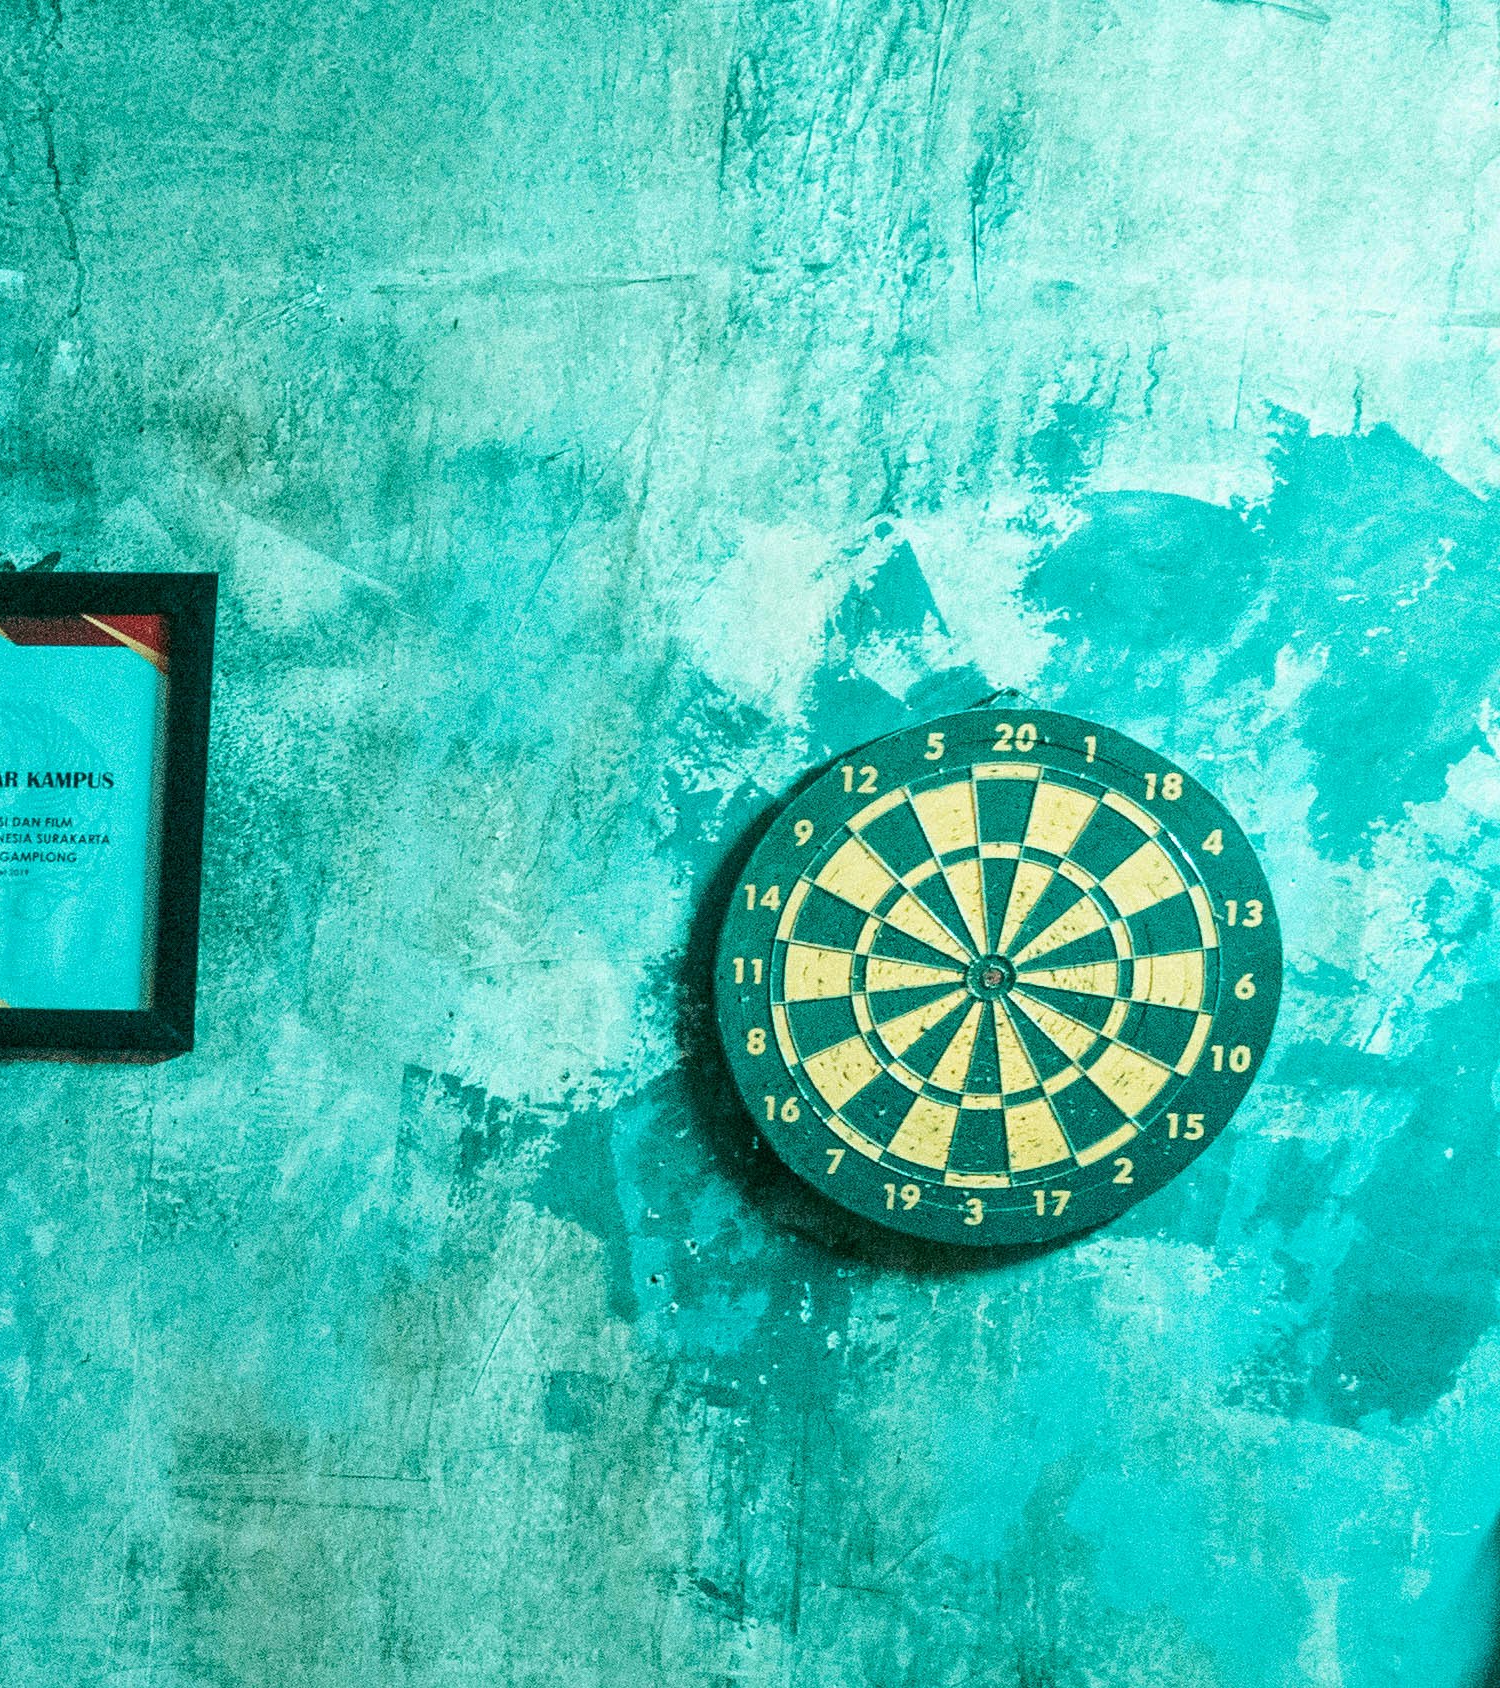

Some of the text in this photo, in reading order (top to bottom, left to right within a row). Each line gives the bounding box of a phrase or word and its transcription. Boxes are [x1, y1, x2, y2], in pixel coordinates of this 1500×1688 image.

[923, 731, 946, 760] 5
[992, 723, 1039, 752] 20
[1082, 735, 1098, 763] 1
[27, 771, 115, 789] KAMPUS
[841, 765, 880, 794] 12
[1143, 772, 1185, 801] 18
[12, 816, 41, 828] DAN
[44, 817, 74, 828] FILM
[793, 819, 815, 846] 9
[36, 833, 111, 845] SURAKARTA
[1201, 828, 1224, 856] 4
[744, 884, 781, 912] 14
[1224, 899, 1264, 927] 13
[733, 957, 764, 985] 11
[1234, 973, 1257, 1000] 6
[746, 1028, 767, 1055] 8
[1211, 1044, 1252, 1074] 10
[763, 1095, 800, 1123] 16
[1166, 1112, 1206, 1141] 15
[825, 1148, 845, 1174] 7
[1113, 1156, 1135, 1185] 2
[883, 1183, 922, 1211] 19
[1032, 1189, 1072, 1217] 17
[964, 1198, 986, 1226] 3
